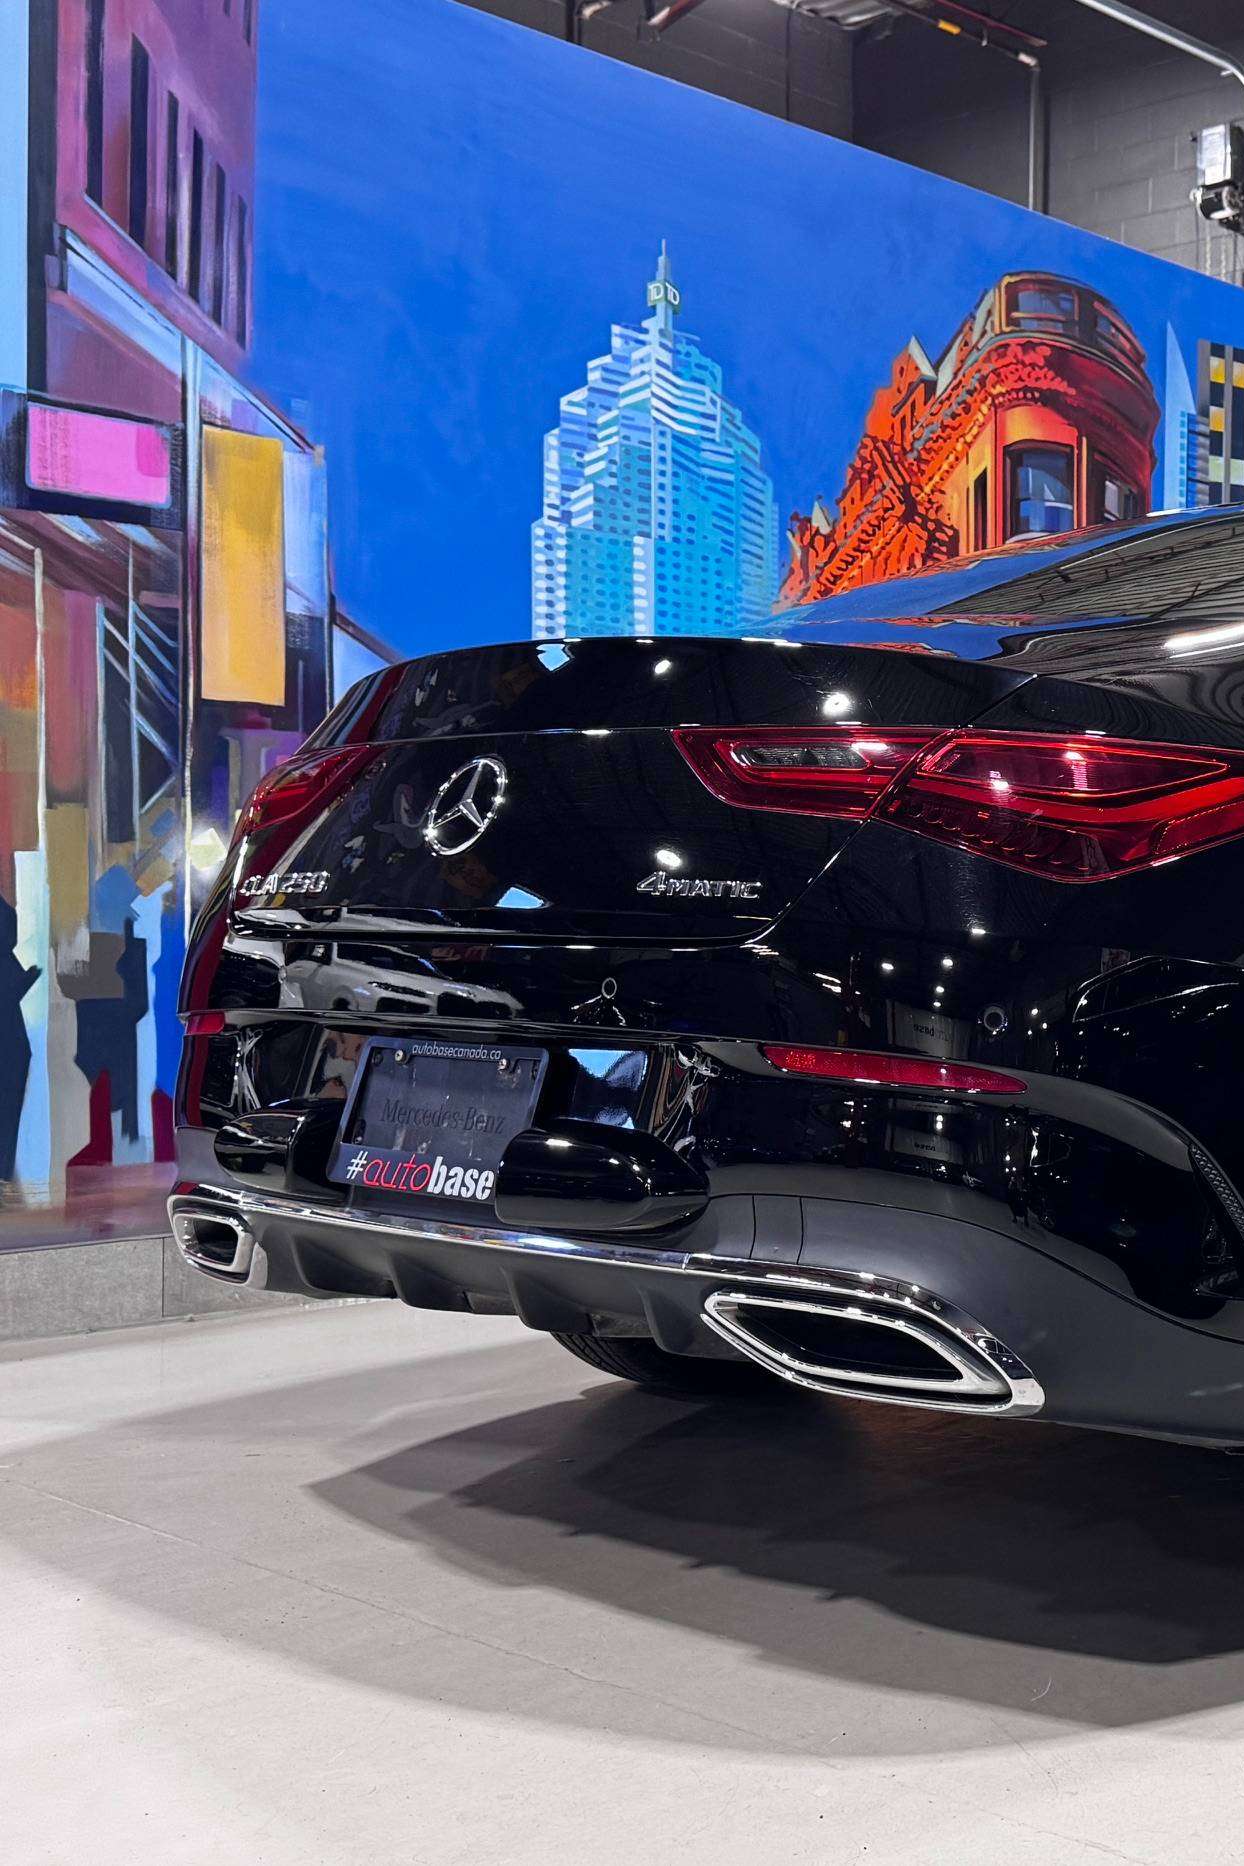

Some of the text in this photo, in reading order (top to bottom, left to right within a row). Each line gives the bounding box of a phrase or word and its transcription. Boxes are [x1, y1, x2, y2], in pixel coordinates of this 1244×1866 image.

[240, 870, 330, 896] CLA 250
[636, 871, 761, 898] 4MATIC
[412, 1041, 501, 1060] autobasecanada.ca
[380, 1099, 506, 1134] Mercedes-Benz
[346, 1150, 496, 1201] #autobase
